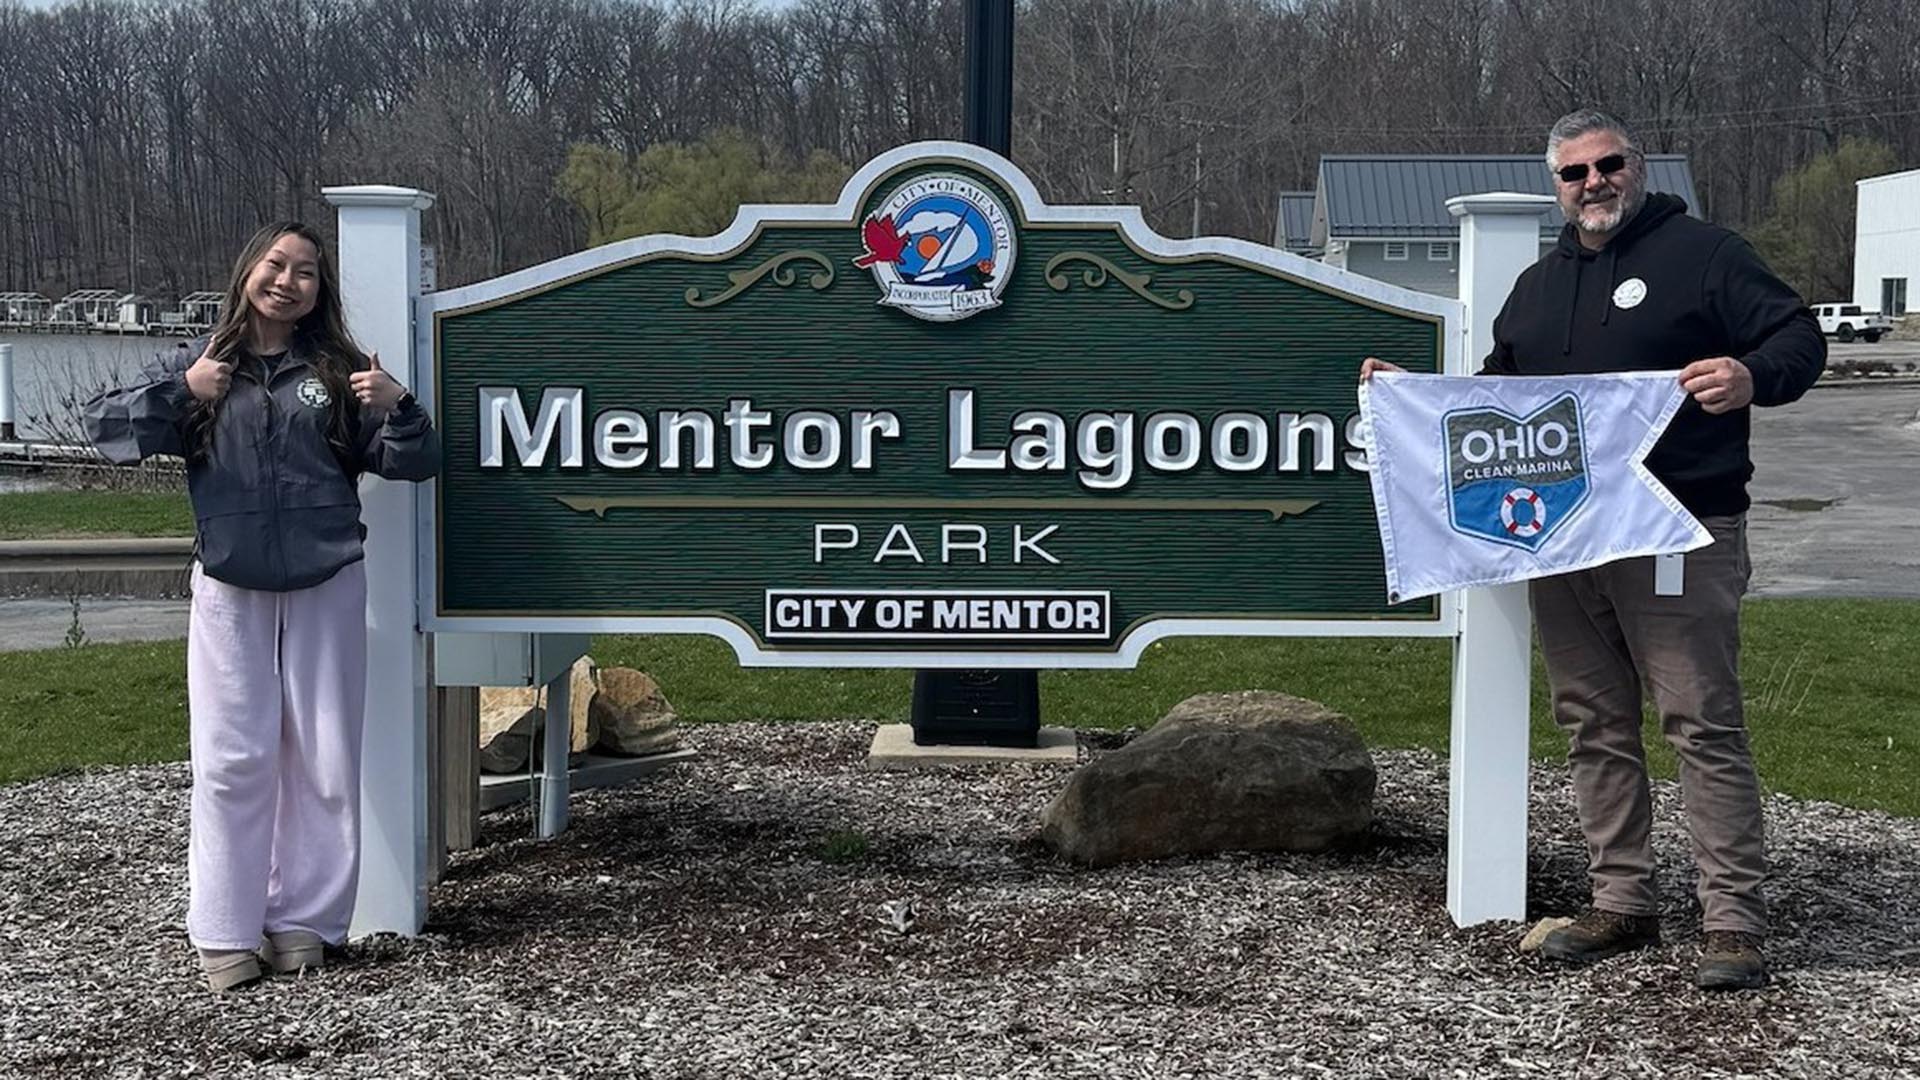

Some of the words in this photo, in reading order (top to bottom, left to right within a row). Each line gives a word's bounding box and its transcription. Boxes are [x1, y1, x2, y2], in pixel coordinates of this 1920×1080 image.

[893, 183, 930, 210] CITY
[936, 180, 960, 193] OF
[966, 185, 1009, 251] MENTOR
[956, 291, 988, 308] 1963
[478, 386, 900, 469] Mentor
[1461, 421, 1569, 464] OHIO
[1463, 465, 1513, 481] CLEAN
[1516, 459, 1573, 476] MARINA
[814, 523, 1061, 564] PARK
[775, 598, 866, 629] CITY
[875, 599, 924, 629] OF
[932, 600, 1101, 630] MENTOR
